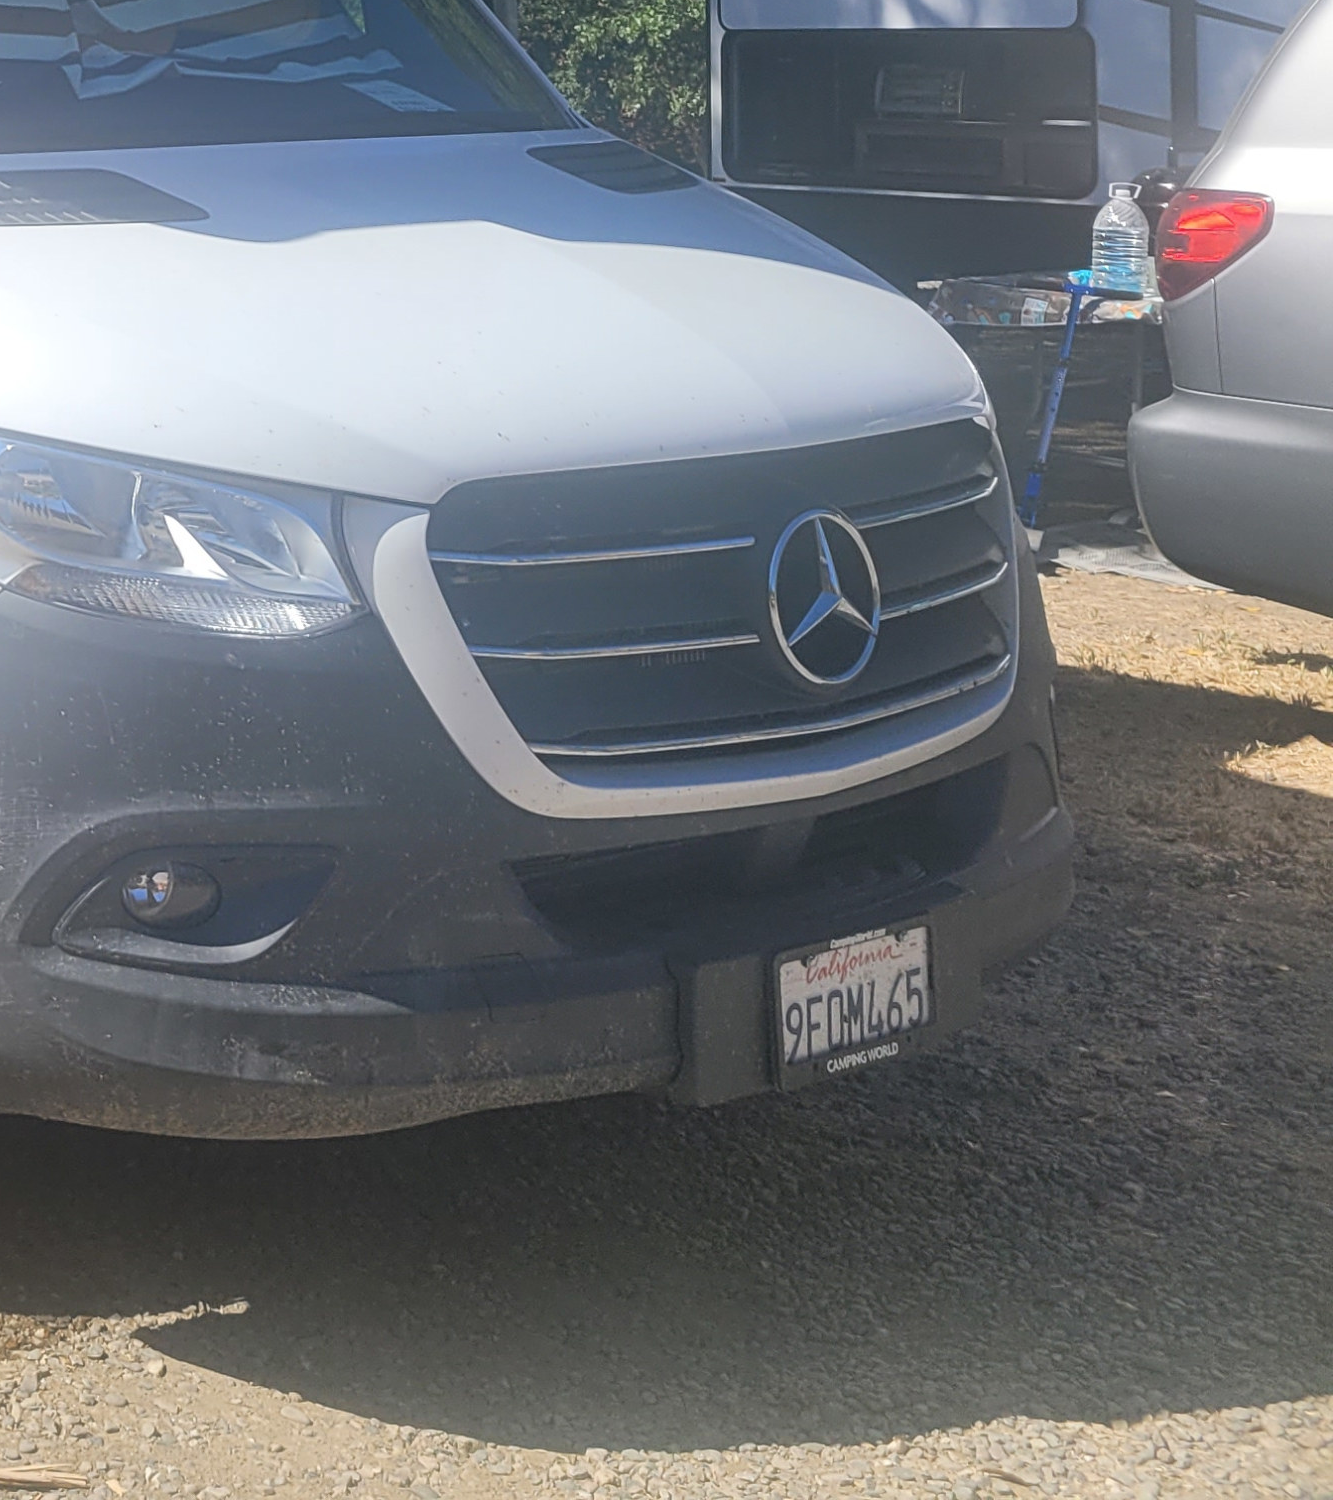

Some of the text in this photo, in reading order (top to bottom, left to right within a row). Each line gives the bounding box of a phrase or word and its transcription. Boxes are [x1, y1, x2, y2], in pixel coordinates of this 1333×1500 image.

[805, 943, 903, 985] California
[826, 1041, 899, 1074] CAMPING WORLD
